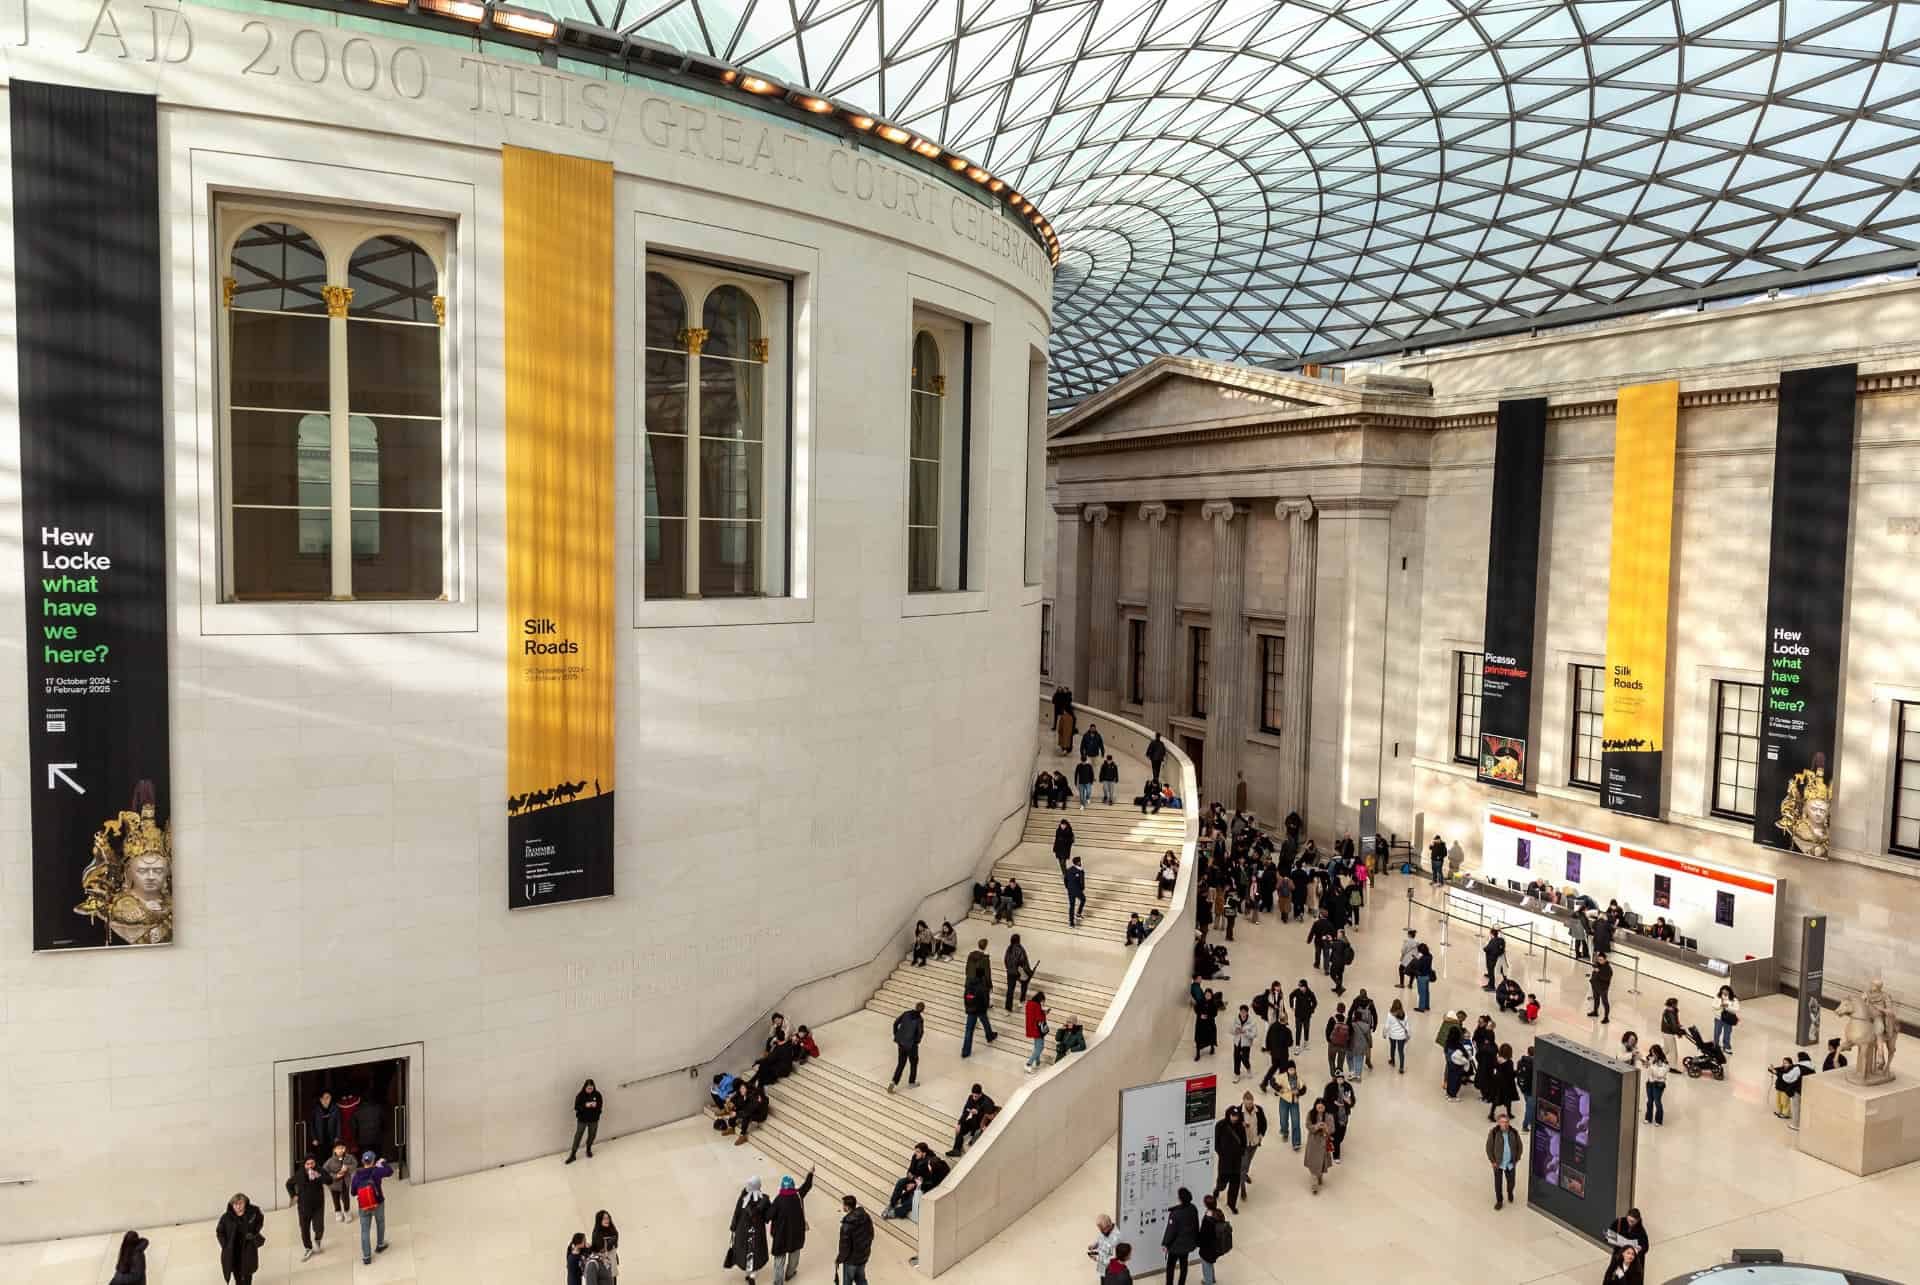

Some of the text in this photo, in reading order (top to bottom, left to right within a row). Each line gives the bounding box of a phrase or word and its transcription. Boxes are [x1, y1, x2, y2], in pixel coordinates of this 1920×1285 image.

[77, 0, 193, 64] AD
[241, 21, 428, 99] 2000
[461, 57, 609, 134] THIS
[640, 98, 809, 183] GREAT
[828, 149, 939, 225] COURT
[42, 527, 94, 546] Hew
[43, 551, 111, 570] Locke
[42, 575, 99, 593] what
[43, 598, 97, 616] have
[44, 626, 78, 639] we
[524, 619, 556, 635] Silk
[1774, 627, 1802, 641] Hew
[45, 645, 109, 663] here?
[525, 639, 579, 656] Roads
[1773, 642, 1810, 656] Locke
[1772, 656, 1803, 670] what
[1614, 665, 1632, 677] Silk
[1771, 669, 1801, 684] have
[56, 677, 88, 686] October
[89, 677, 111, 685] 2024
[1614, 677, 1644, 690] Roads
[53, 686, 88, 695] February
[89, 685, 111, 693] 2025
[1771, 686, 1790, 696] we
[1769, 697, 1806, 712] here?
